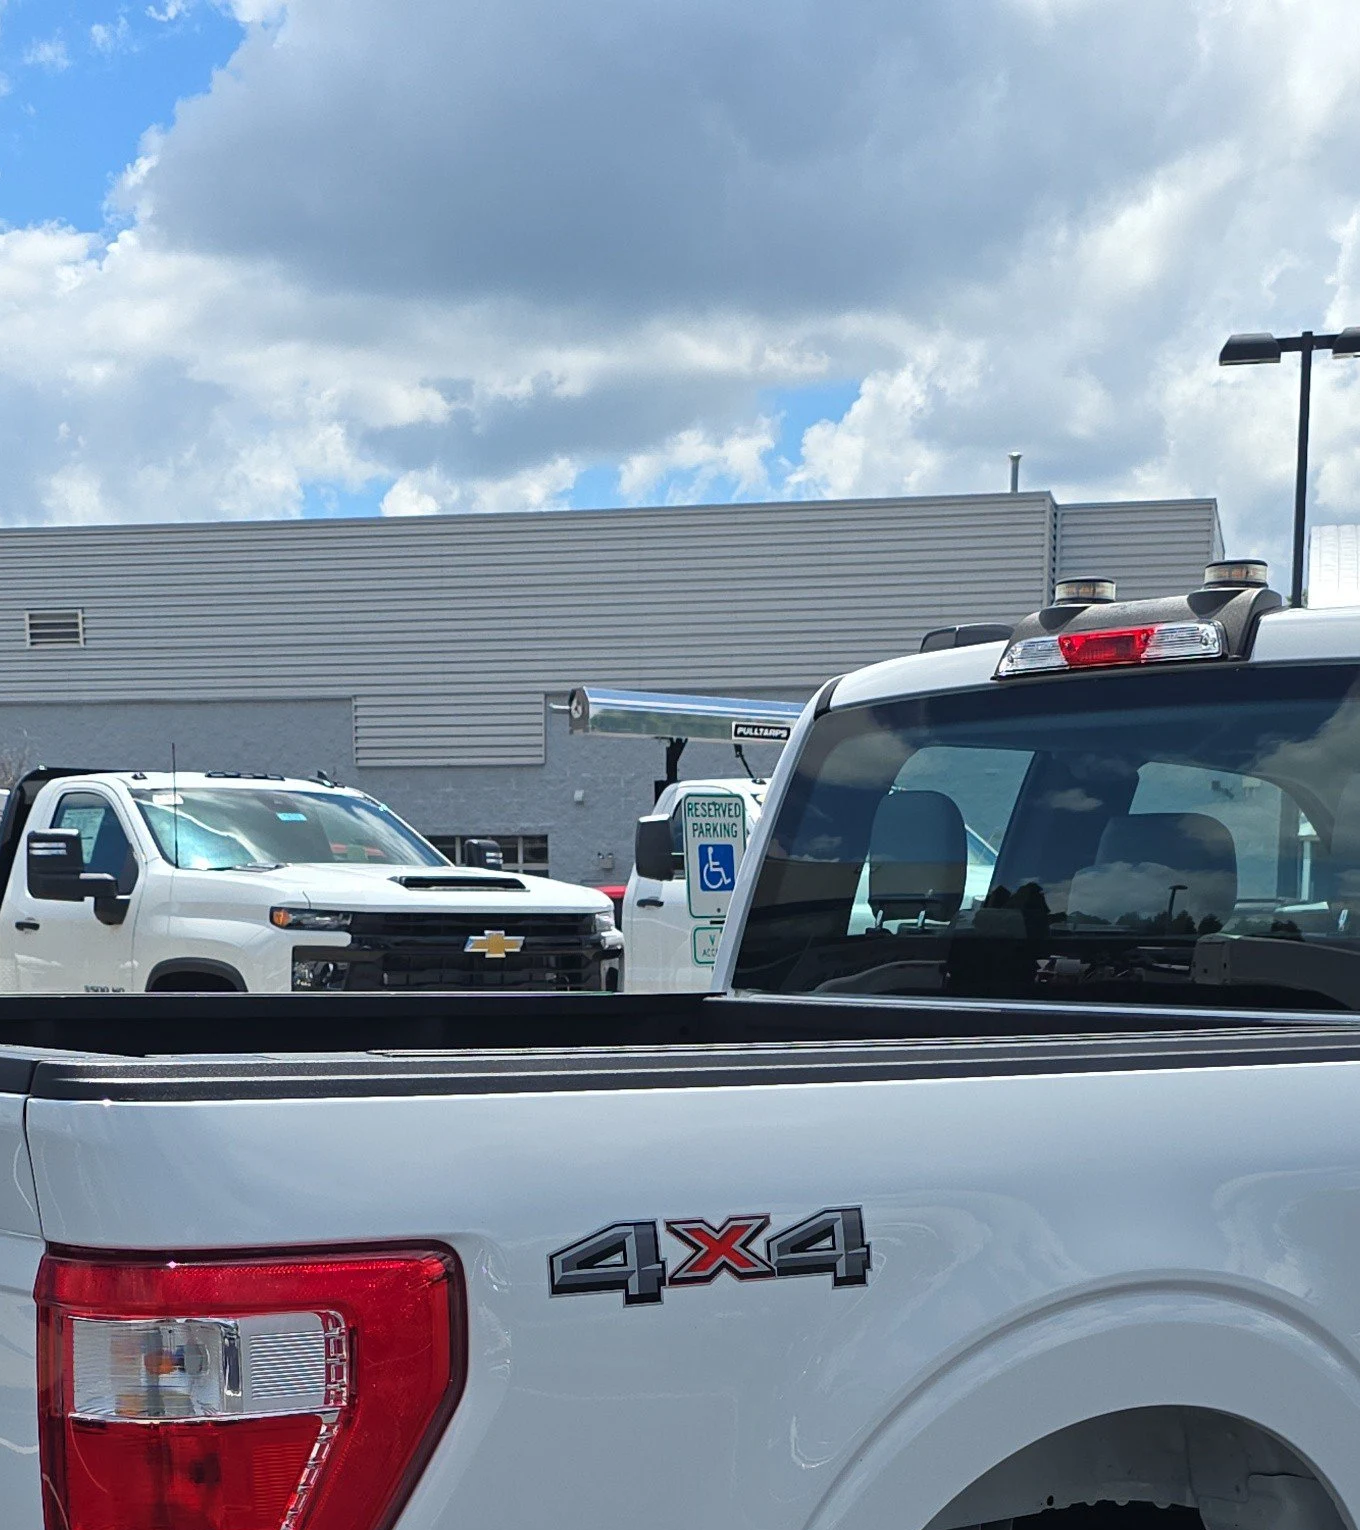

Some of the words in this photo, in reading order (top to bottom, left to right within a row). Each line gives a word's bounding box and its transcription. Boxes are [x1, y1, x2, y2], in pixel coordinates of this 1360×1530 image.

[736, 726, 788, 738] PULLTARPS
[687, 801, 741, 818] RESERVED
[692, 822, 738, 838] PARKING
